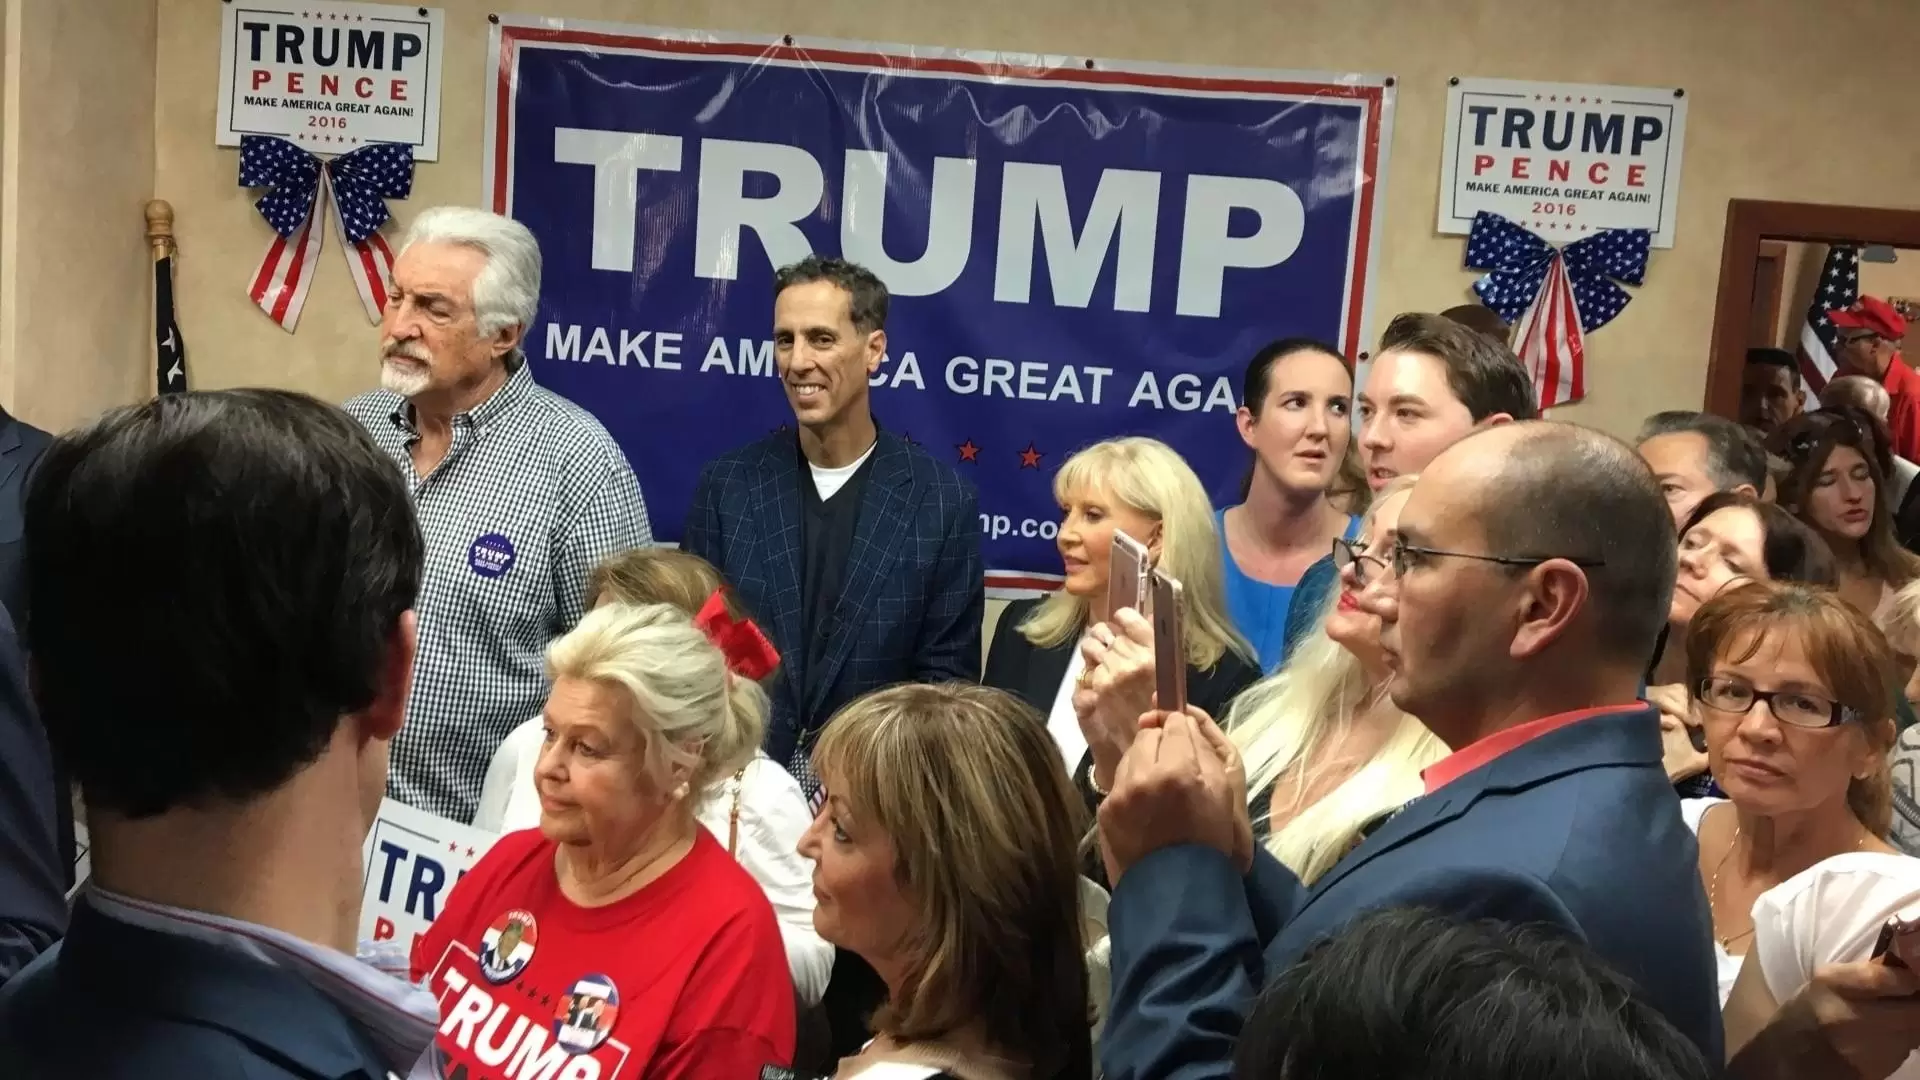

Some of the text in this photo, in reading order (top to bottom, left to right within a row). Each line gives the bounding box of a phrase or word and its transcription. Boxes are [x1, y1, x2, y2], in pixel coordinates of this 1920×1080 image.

[243, 22, 422, 71] TRUMP
[252, 70, 408, 101] PENCE
[244, 96, 414, 117] MAKE AMERICA GREAT AGAIN!
[308, 116, 347, 129] 2016
[1468, 106, 1663, 156] TRUMP
[1474, 155, 1646, 187] PENCE
[1465, 181, 1651, 203] MAKE AMERICA GREAT AGAIN!
[554, 127, 1305, 318] TRUMP
[1532, 202, 1576, 216] 2016
[545, 323, 683, 370] MAKE
[945, 356, 1113, 405] GREAT
[1128, 371, 1244, 414] AGA
